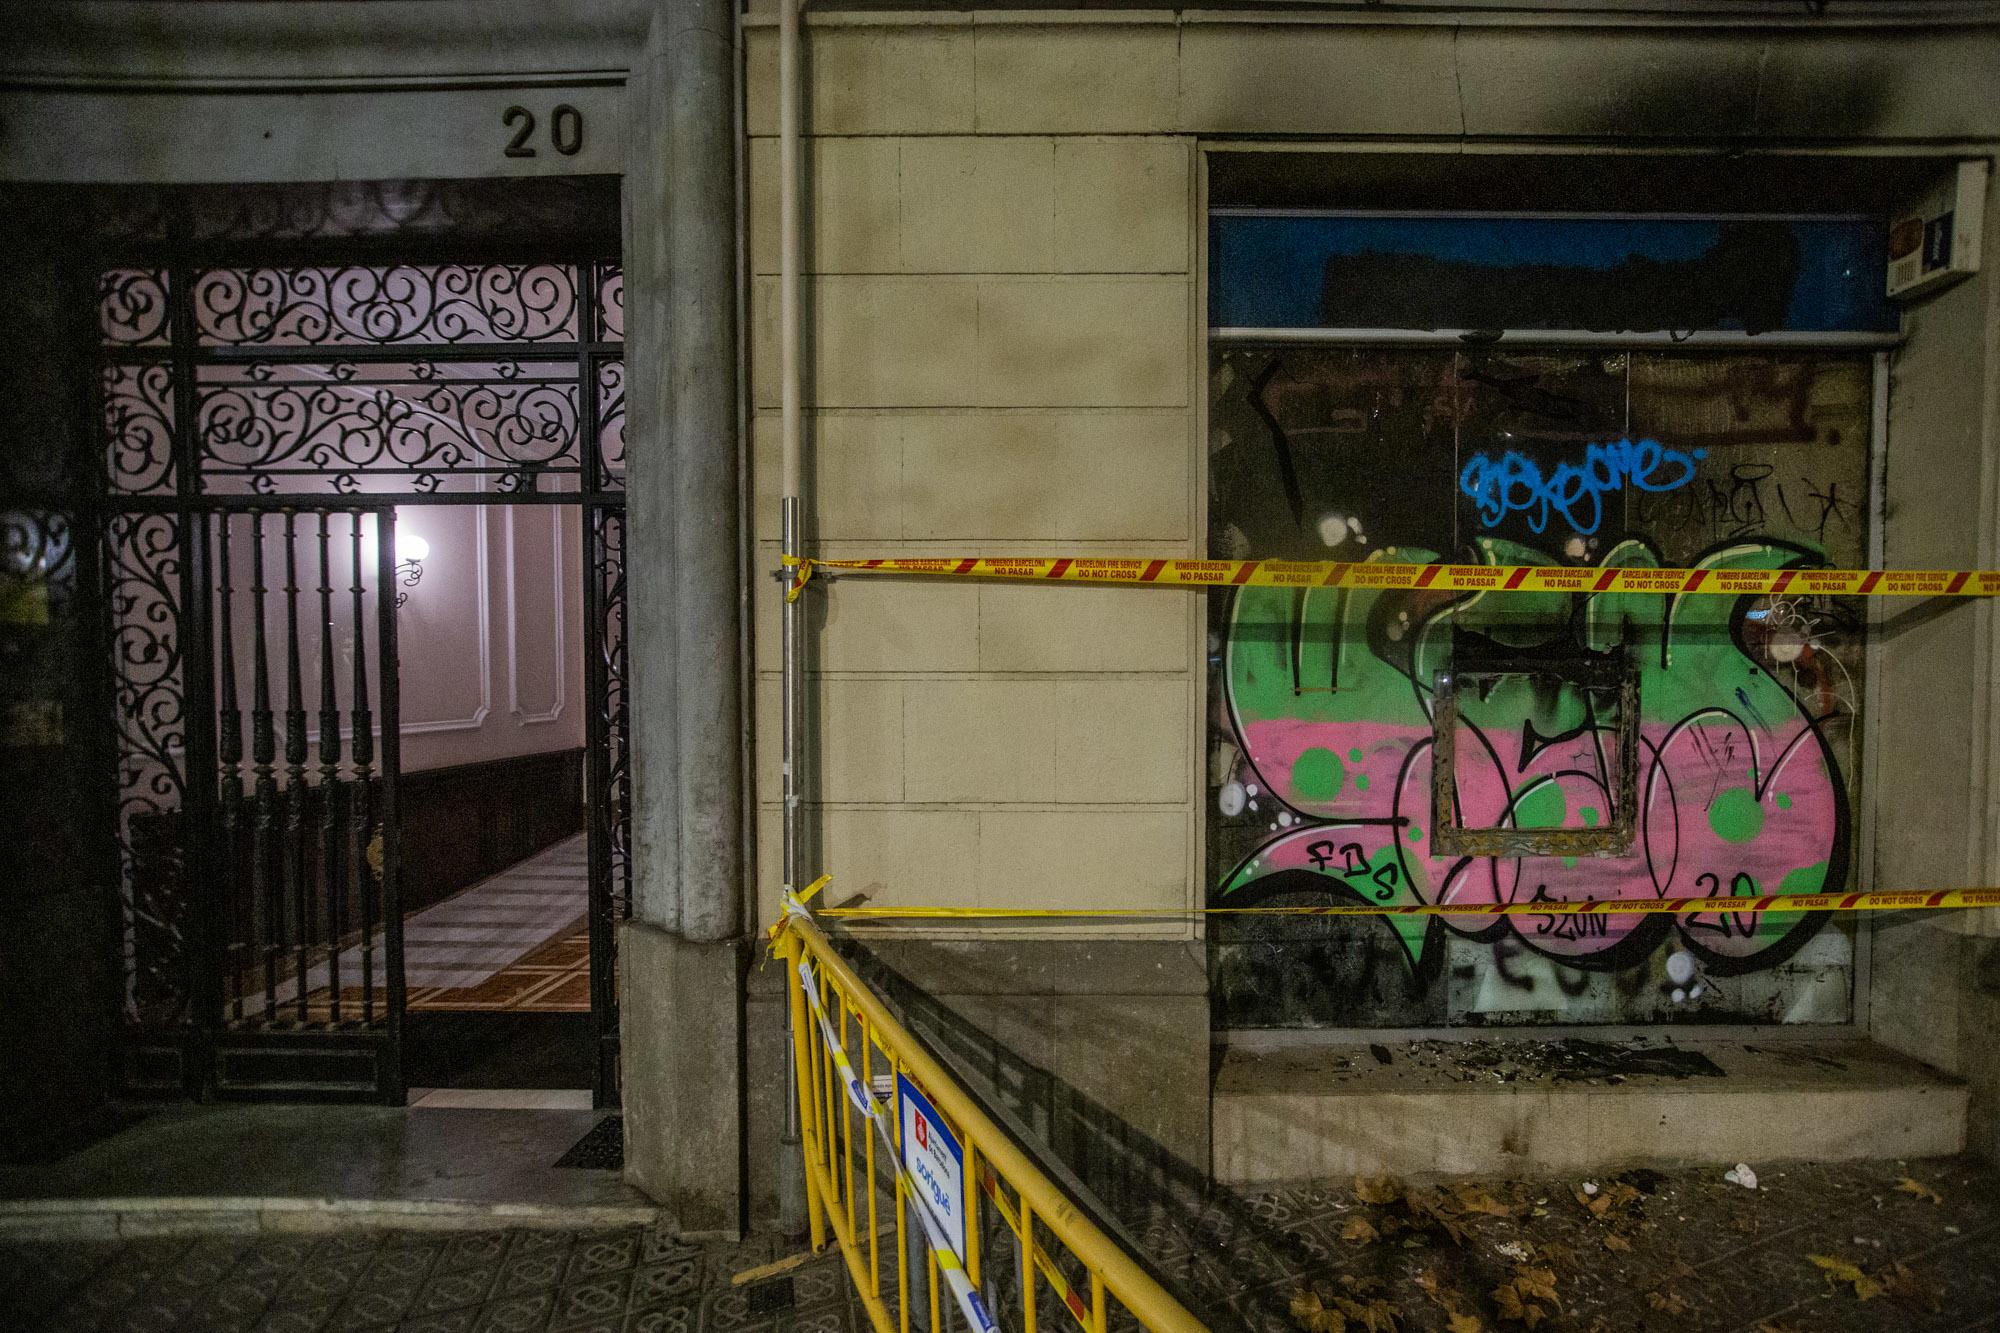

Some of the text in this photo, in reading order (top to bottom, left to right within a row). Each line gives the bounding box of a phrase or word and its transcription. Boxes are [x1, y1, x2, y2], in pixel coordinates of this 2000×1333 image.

[503, 105, 583, 158] 20
[985, 559, 1045, 568] BOMBEROS BARCELONA
[1076, 560, 1142, 570] BARCELONA FIRE SERVICE
[1174, 562, 1231, 572] BOMBERS BARCELONA
[1008, 568, 1034, 576] PASAR
[1353, 565, 1384, 574] BARCELONA
[1474, 568, 1504, 576] BARCELONA
[1536, 569, 1593, 578] BOMBEROS BARCELONA
[1078, 570, 1137, 580] DO NOT CROSS
[1180, 572, 1224, 582] NO PASSAR
[1273, 574, 1312, 583] NO PASAR
[1622, 570, 1686, 580] BARCELONA FIRE SERVICE
[1740, 572, 1770, 580] BARCELONA
[1355, 576, 1412, 584] DO NOT CROSS
[1454, 578, 1496, 586] NO PASSAR
[1557, 580, 1582, 588] PASAR
[1624, 580, 1680, 590] DO NOT CROSS
[1720, 582, 1763, 590] NO PASSAR
[1810, 582, 1847, 591] NO PASAR
[1888, 582, 1943, 592] DO NOT CROSS
[1984, 583, 1994, 592] NO
[1806, 899, 1829, 907] PASAR
[1884, 896, 1900, 904] NOT
[1900, 896, 1923, 904] CROSS
[1609, 902, 1665, 910] DO NOT CROSS
[916, 1156, 951, 1216] sorigué
